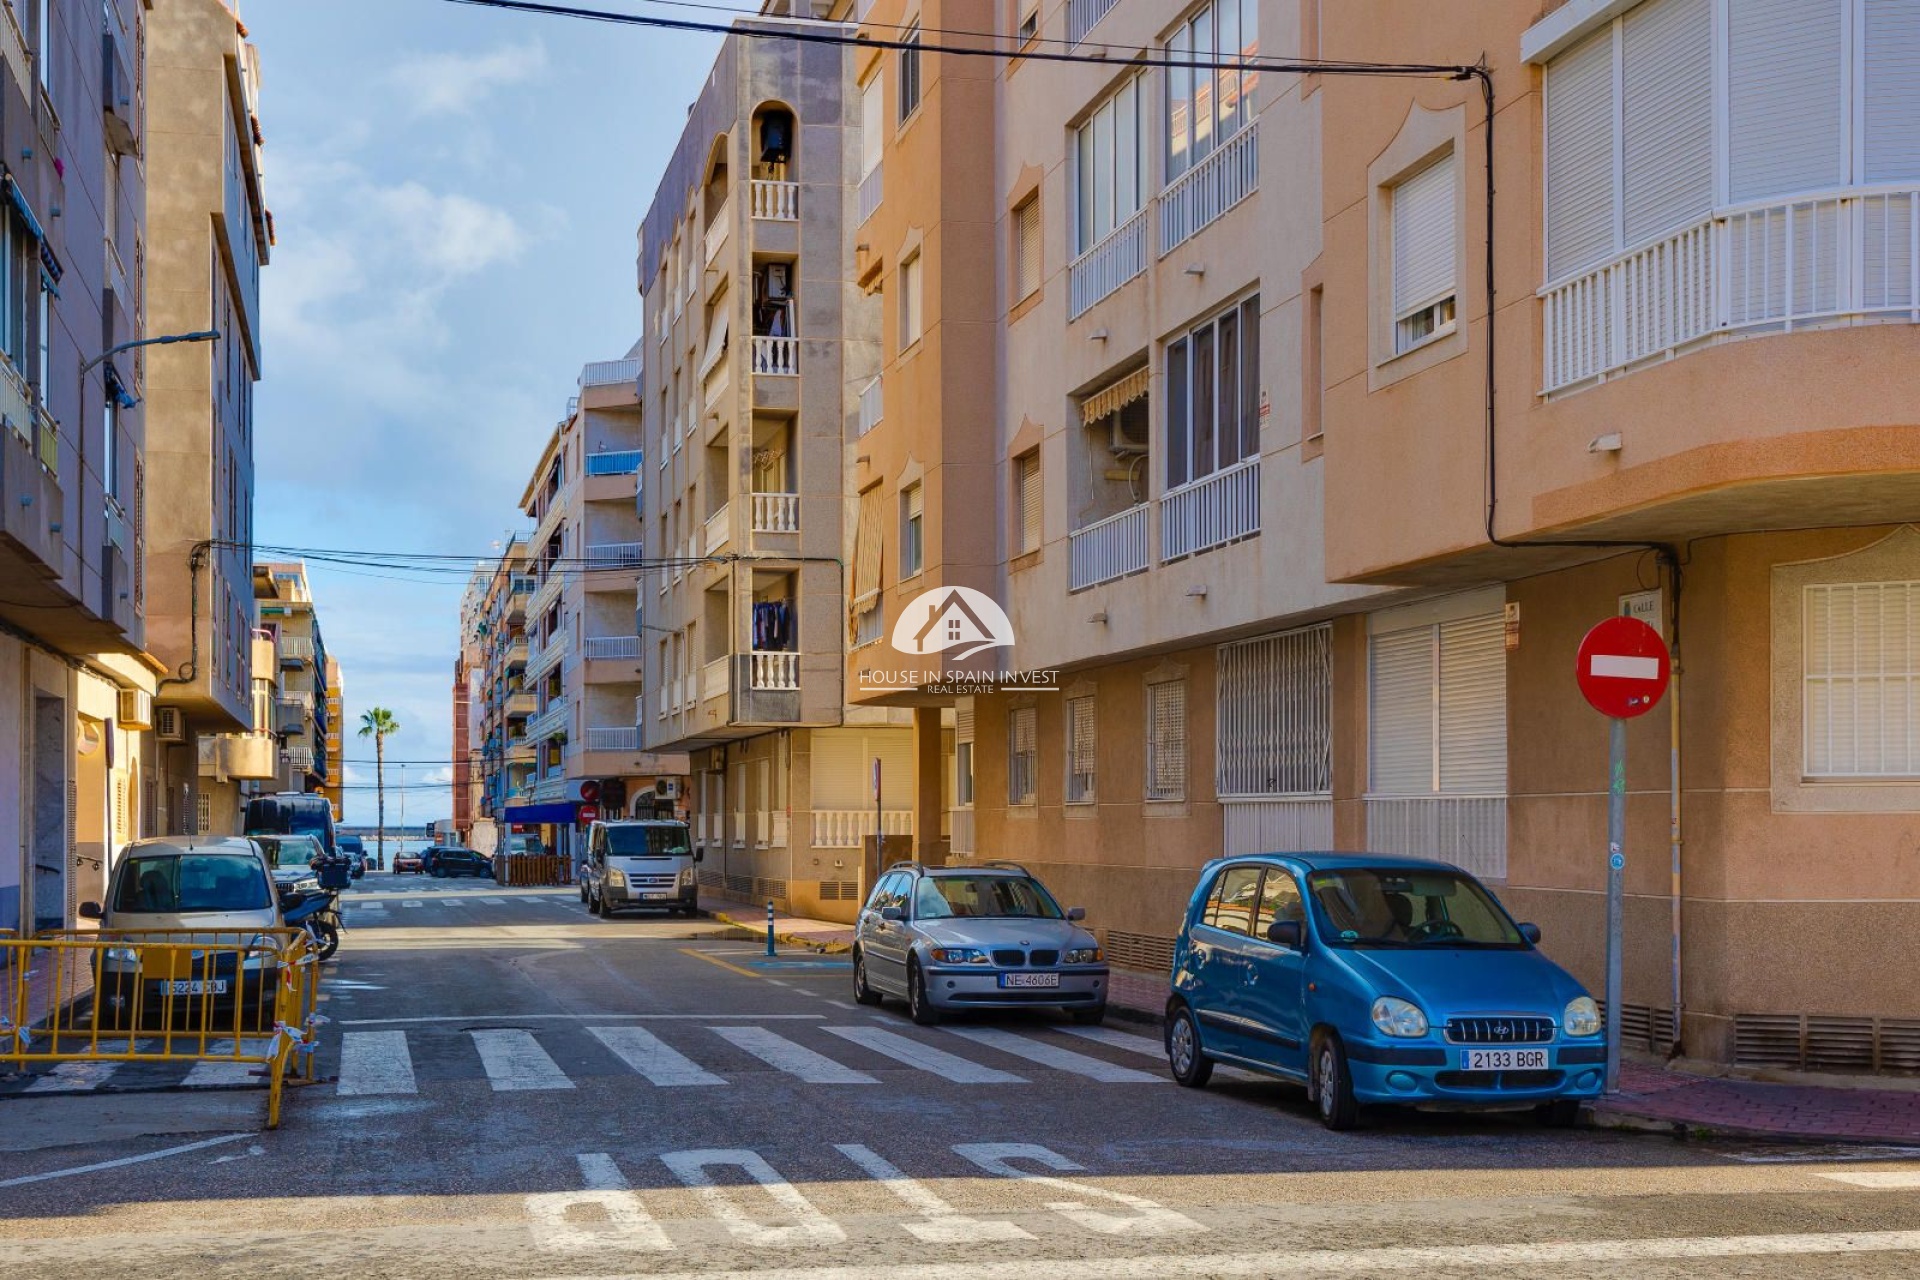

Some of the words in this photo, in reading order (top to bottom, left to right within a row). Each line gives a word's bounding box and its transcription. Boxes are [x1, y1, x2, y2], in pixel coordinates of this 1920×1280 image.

[1633, 601, 1655, 613] CALLE
[1006, 974, 1022, 986] NE
[1025, 974, 1057, 986] 4606E
[1473, 1052, 1511, 1068] 2133
[1516, 1052, 1544, 1067] BGR
[524, 1143, 1211, 1250] STOP
